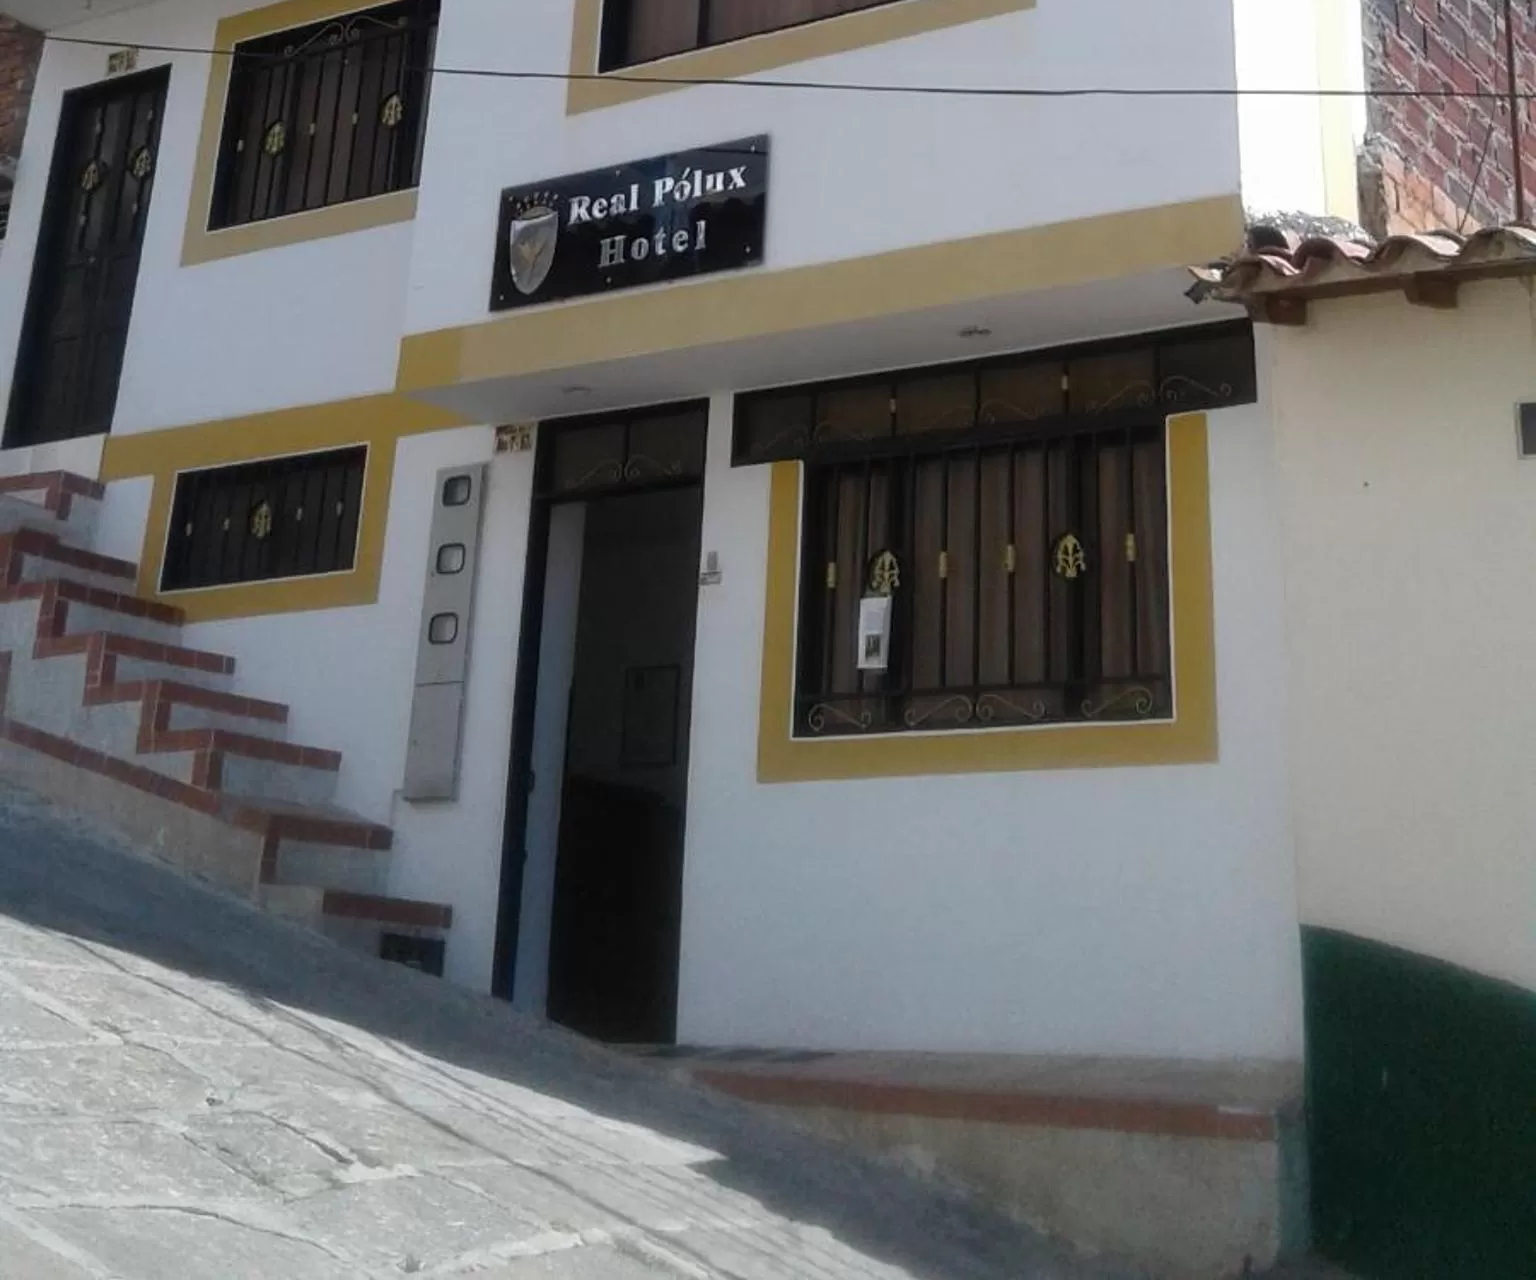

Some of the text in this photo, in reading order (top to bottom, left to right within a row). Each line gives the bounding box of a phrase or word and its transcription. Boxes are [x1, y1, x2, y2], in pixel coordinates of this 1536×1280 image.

[567, 166, 747, 224] Real Pólux
[598, 221, 706, 268] Hotel
